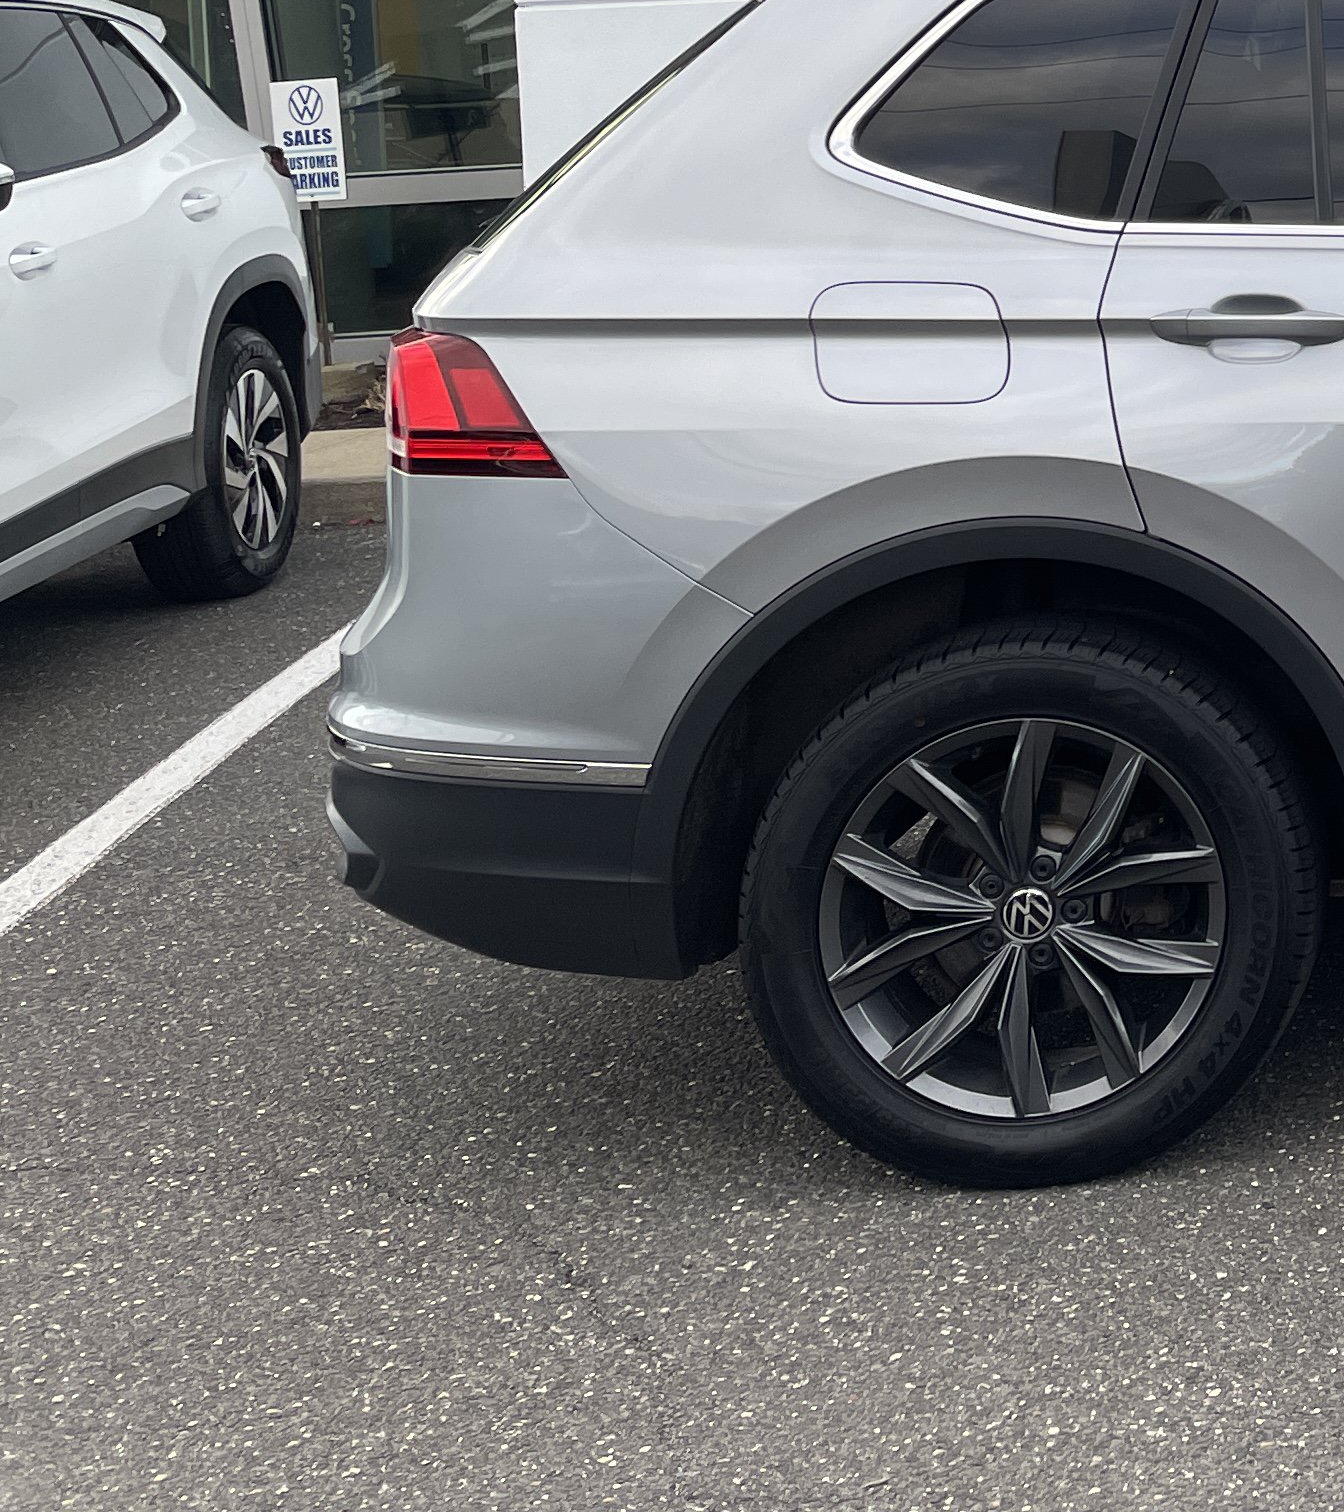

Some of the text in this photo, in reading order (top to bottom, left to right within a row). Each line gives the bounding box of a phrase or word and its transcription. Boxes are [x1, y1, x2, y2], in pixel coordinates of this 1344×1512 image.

[283, 128, 333, 147] SALES
[288, 155, 338, 171] USTOMER
[291, 171, 340, 190] ARKING
